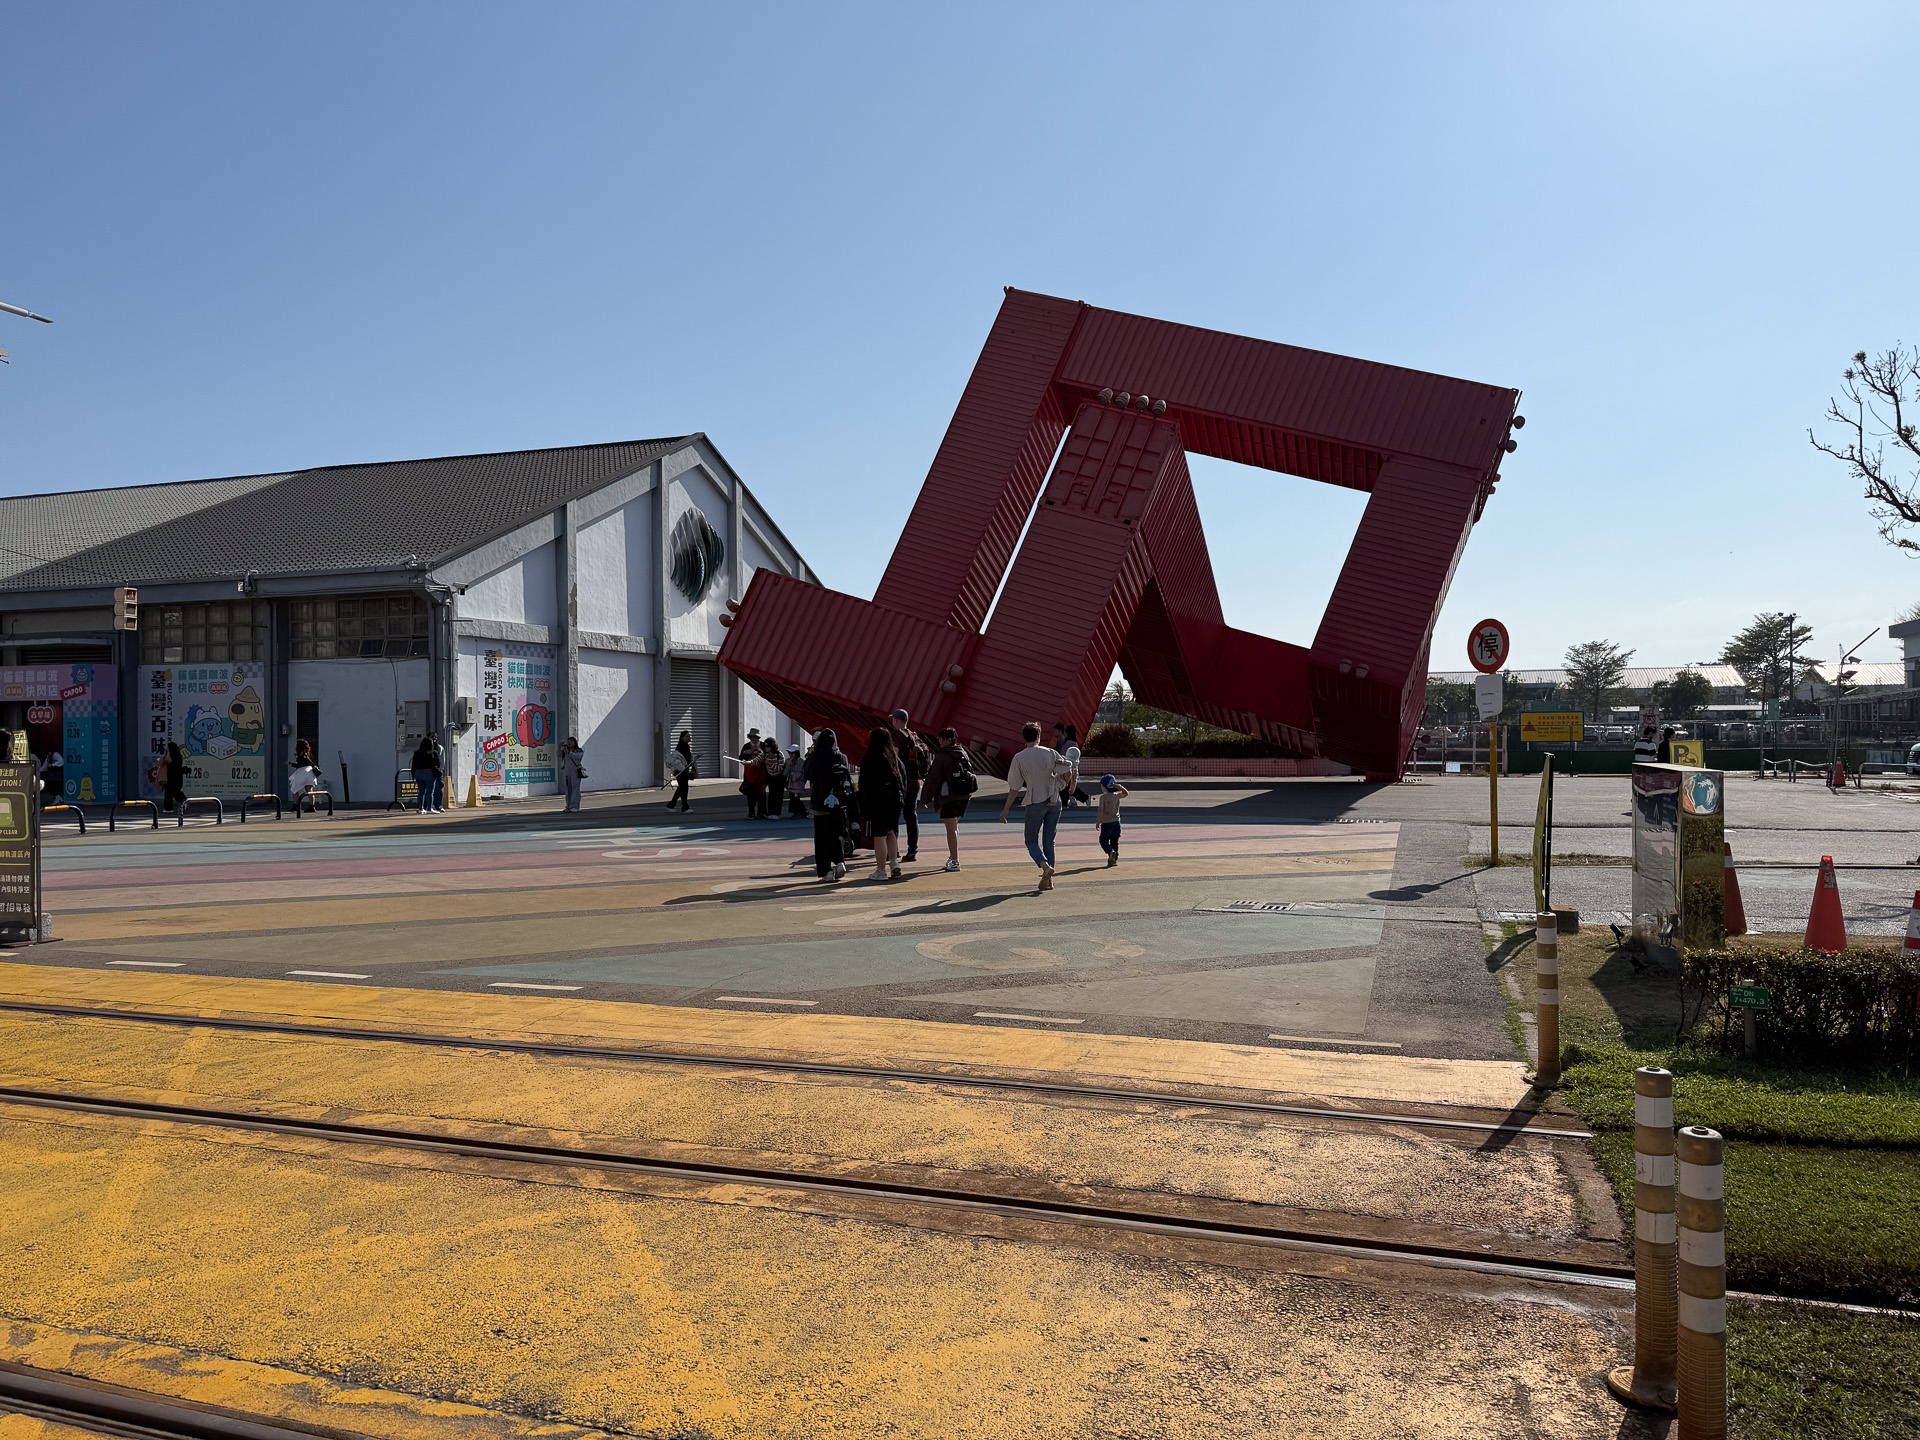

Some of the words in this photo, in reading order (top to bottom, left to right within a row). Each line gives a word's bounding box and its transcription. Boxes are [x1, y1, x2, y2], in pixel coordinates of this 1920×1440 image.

[1478, 632, 1498, 659] 停
[178, 682, 208, 693] 快閃店
[507, 676, 533, 689] 快閃店
[26, 684, 58, 697] 快閃店
[63, 686, 83, 698] CAPOO
[484, 649, 497, 731] 臺灣百味
[151, 671, 166, 755] 臺灣百味
[486, 736, 505, 750] CAPOO
[508, 754, 520, 762] 12.26
[1673, 745, 1689, 763] P
[231, 768, 251, 779] 02.22
[1734, 997, 1764, 1005] 7+470.3
